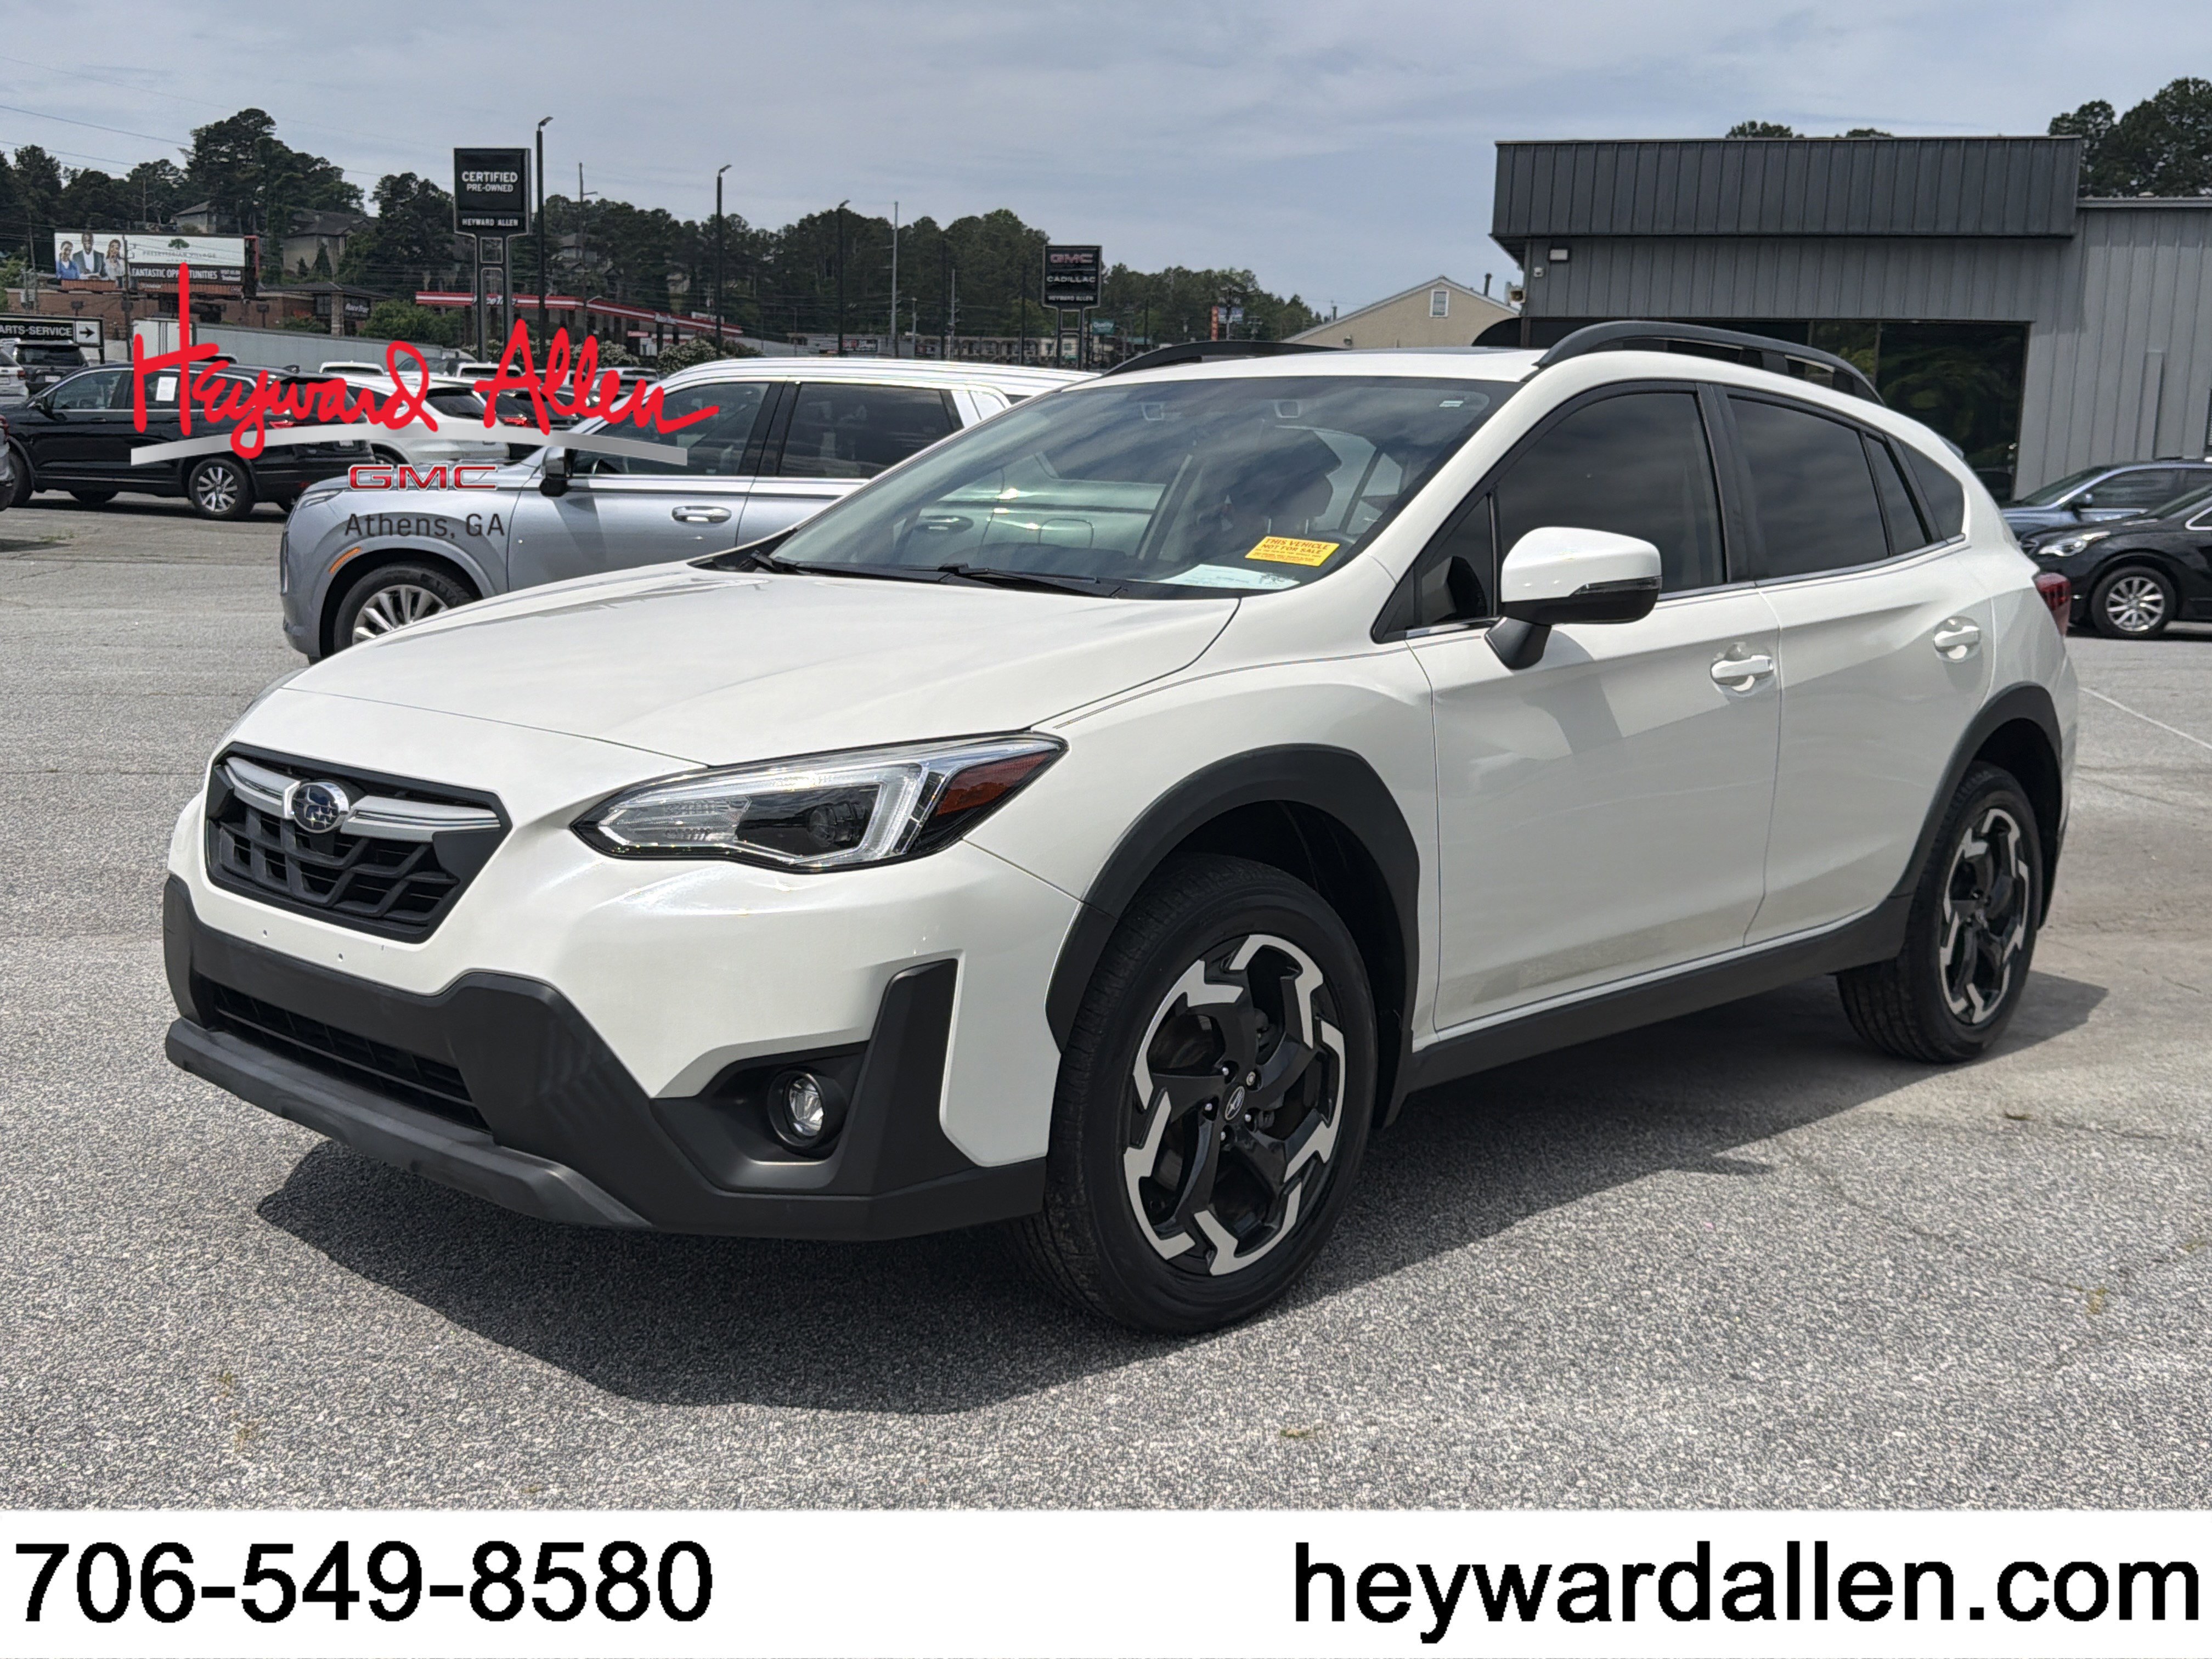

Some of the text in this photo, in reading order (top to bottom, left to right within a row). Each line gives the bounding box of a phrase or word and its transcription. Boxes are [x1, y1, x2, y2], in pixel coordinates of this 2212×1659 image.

[462, 171, 518, 183] CERTIFIED
[466, 184, 514, 192] PRE-OWNED
[1050, 254, 1093, 263] GMC
[131, 268, 166, 278] FANTASTIC
[166, 268, 218, 280] OPPTUNITIES
[1290, 540, 1330, 550] VEHICLE
